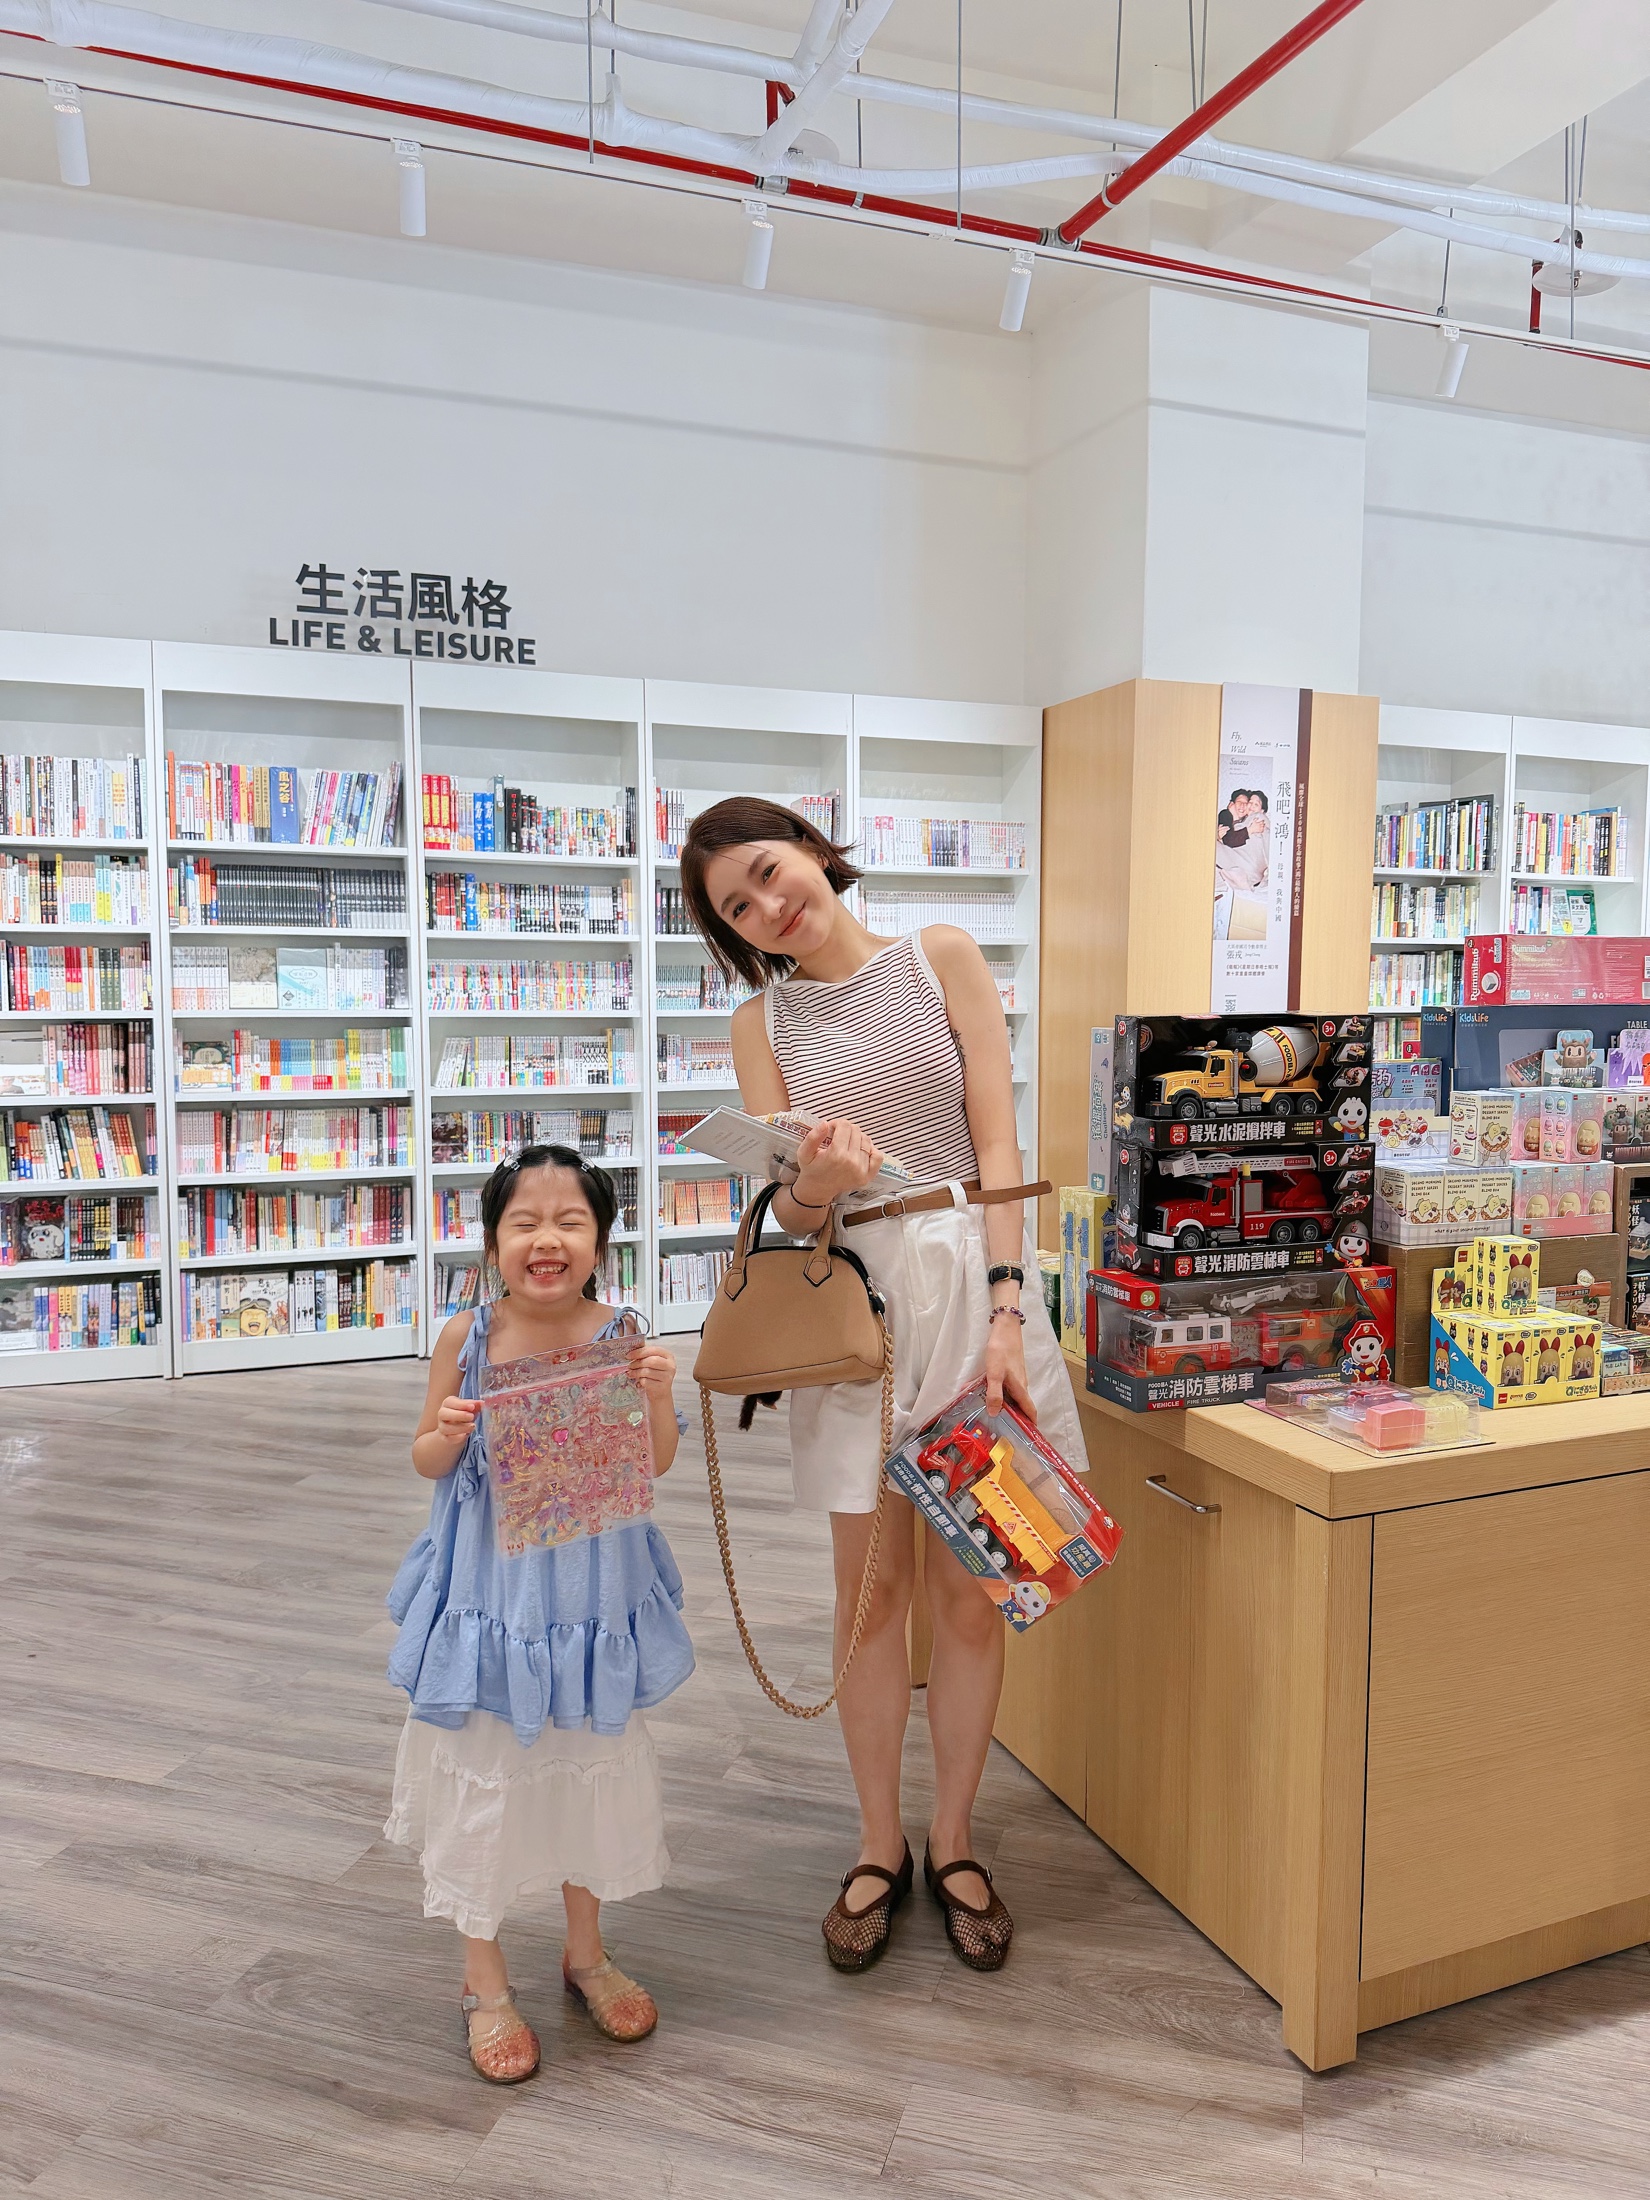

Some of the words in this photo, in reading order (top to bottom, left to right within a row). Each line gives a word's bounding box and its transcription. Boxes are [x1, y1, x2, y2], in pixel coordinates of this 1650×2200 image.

[295, 563, 512, 630] 生活風格
[269, 617, 346, 650] LIFE
[357, 625, 382, 653] &
[393, 627, 536, 665] LEISURE
[1231, 746, 1246, 754] Wild
[1229, 757, 1249, 766] Swans
[279, 771, 290, 804] 風之谷
[1470, 947, 1480, 1001] Rummikub
[1324, 1025, 1334, 1033] 3+
[1626, 1020, 1648, 1029] TABLE
[1190, 1121, 1286, 1143] 聲光水泥攪拌車
[1631, 1204, 1640, 1226] 妖怪
[1250, 1223, 1265, 1231] 119
[1194, 1250, 1290, 1274] 聲光消防雲梯車
[1142, 1294, 1154, 1303] 3+
[1637, 1281, 1646, 1303] 妖怪
[1211, 1343, 1219, 1351] 10
[1169, 1372, 1255, 1399] 消防雲梯車
[1152, 1401, 1180, 1409] VEHICLE
